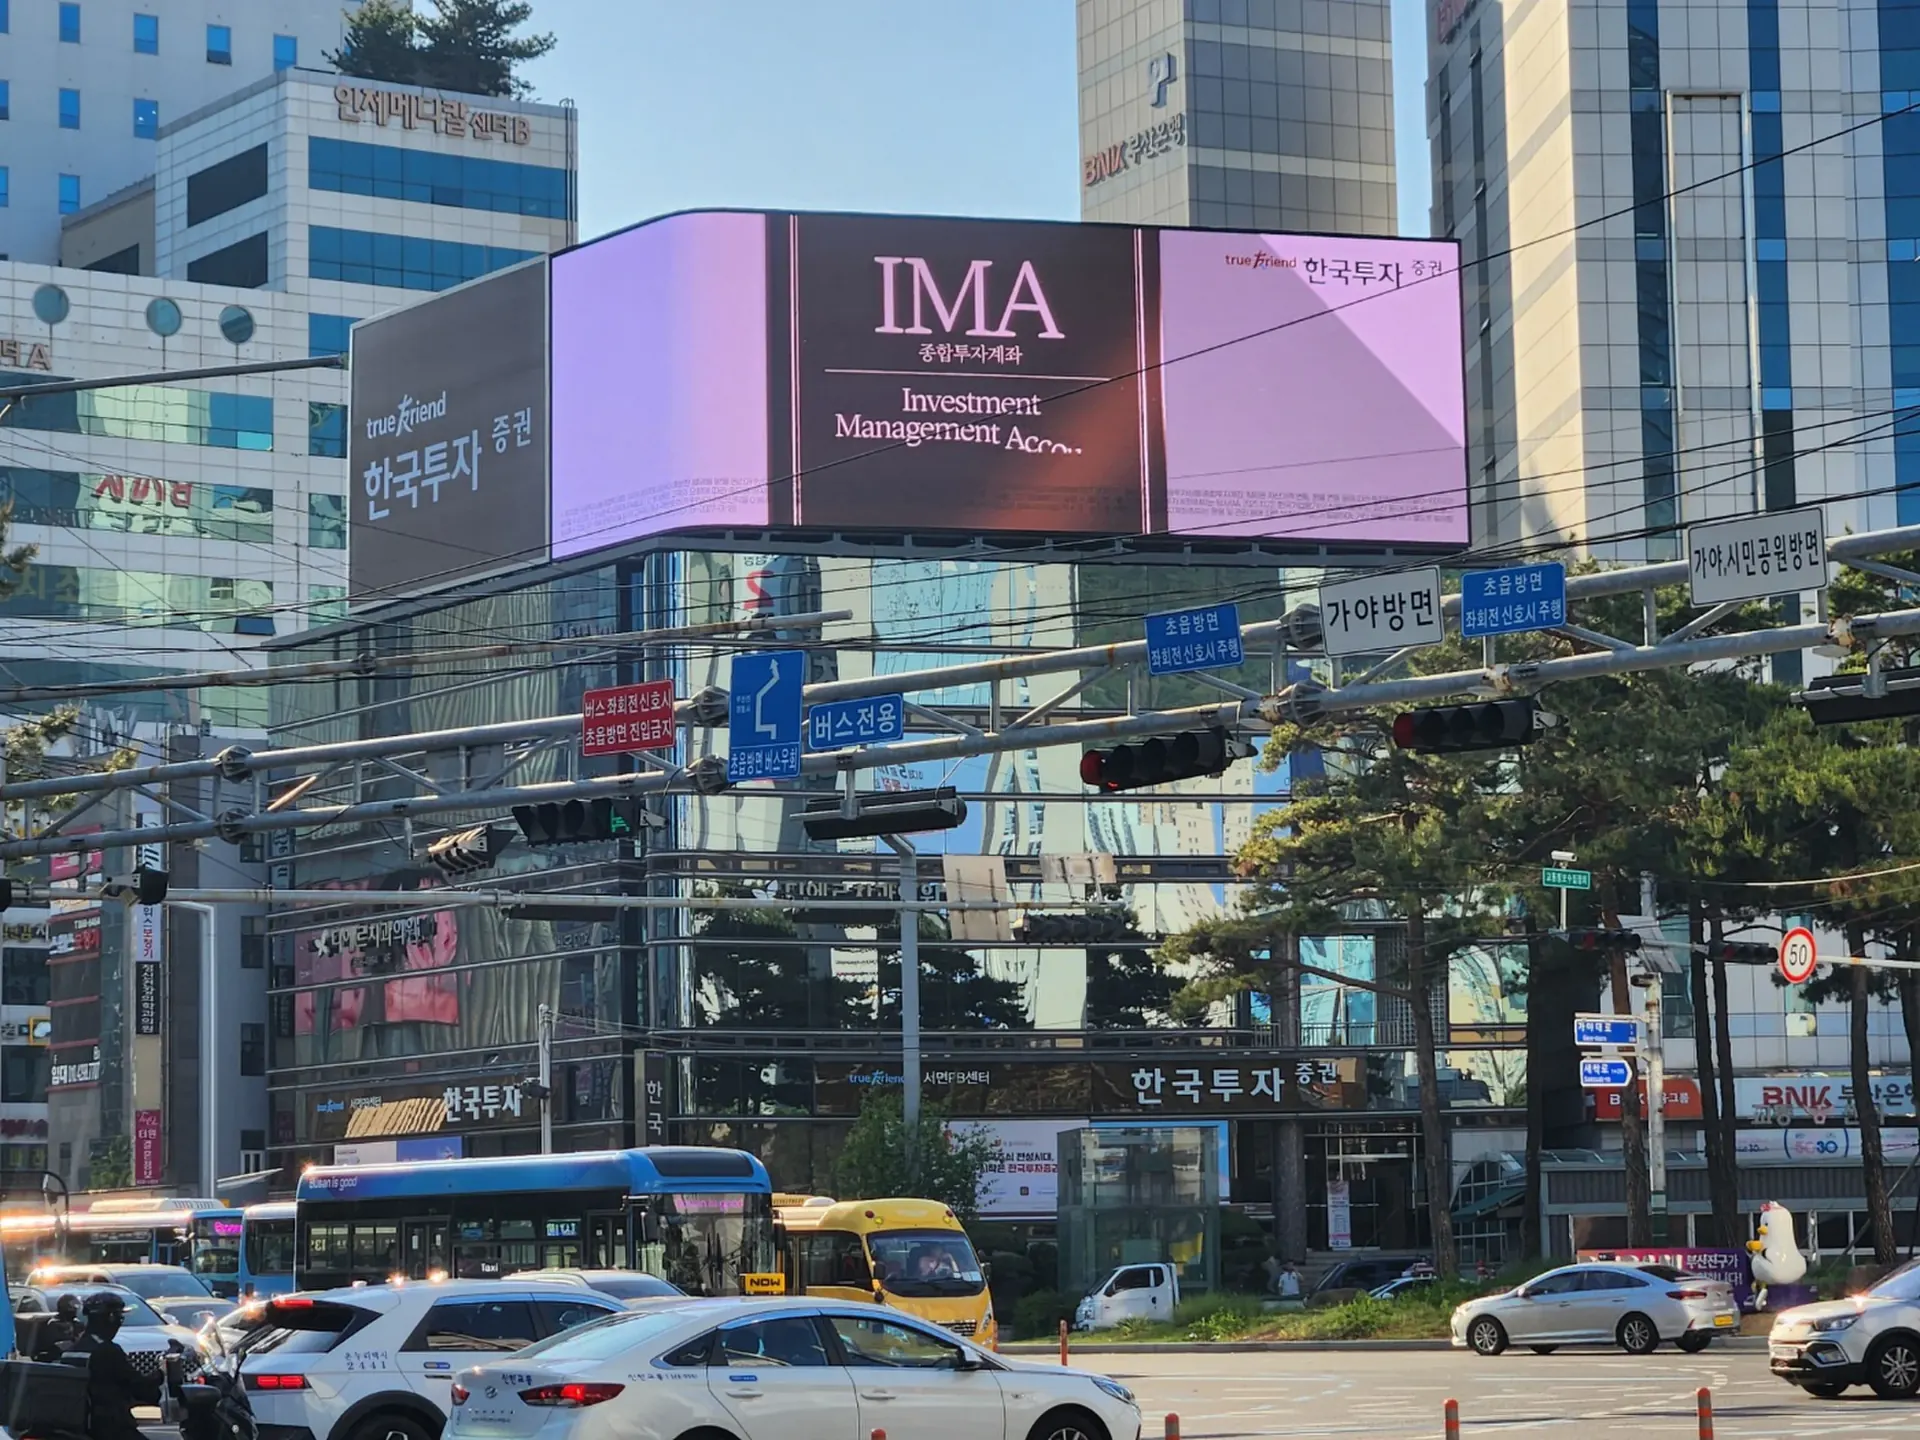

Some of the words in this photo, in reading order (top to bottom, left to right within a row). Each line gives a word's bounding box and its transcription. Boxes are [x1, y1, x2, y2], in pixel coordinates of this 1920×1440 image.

[1083, 140, 1129, 187] BNK
[1303, 258, 1404, 290] 한국투자
[1411, 259, 1443, 278] 증권
[874, 255, 1066, 340] IMA
[918, 343, 1024, 366] 종합투자계좌
[902, 388, 1041, 416] Investment
[835, 413, 1001, 447] Management
[363, 429, 483, 521] 한국투자
[492, 407, 532, 454] 증권
[1484, 570, 1542, 597] 초읍방면
[1165, 611, 1219, 636] 초읍방면
[1327, 587, 1434, 633] 가야방면
[585, 723, 627, 747] 초읍방면
[629, 717, 672, 742] 진입금지
[815, 702, 897, 742] 버스전용
[729, 750, 763, 776] 초읍방면
[764, 746, 798, 773] 버스우회
[1788, 944, 1808, 967] 50
[1131, 1067, 1285, 1104] 한국투자
[1295, 1061, 1338, 1085] 증권
[1763, 1086, 1833, 1109] BNK
[443, 1086, 523, 1122] 한국투자
[481, 1263, 499, 1273] Taxi
[750, 1278, 781, 1287] NOW
